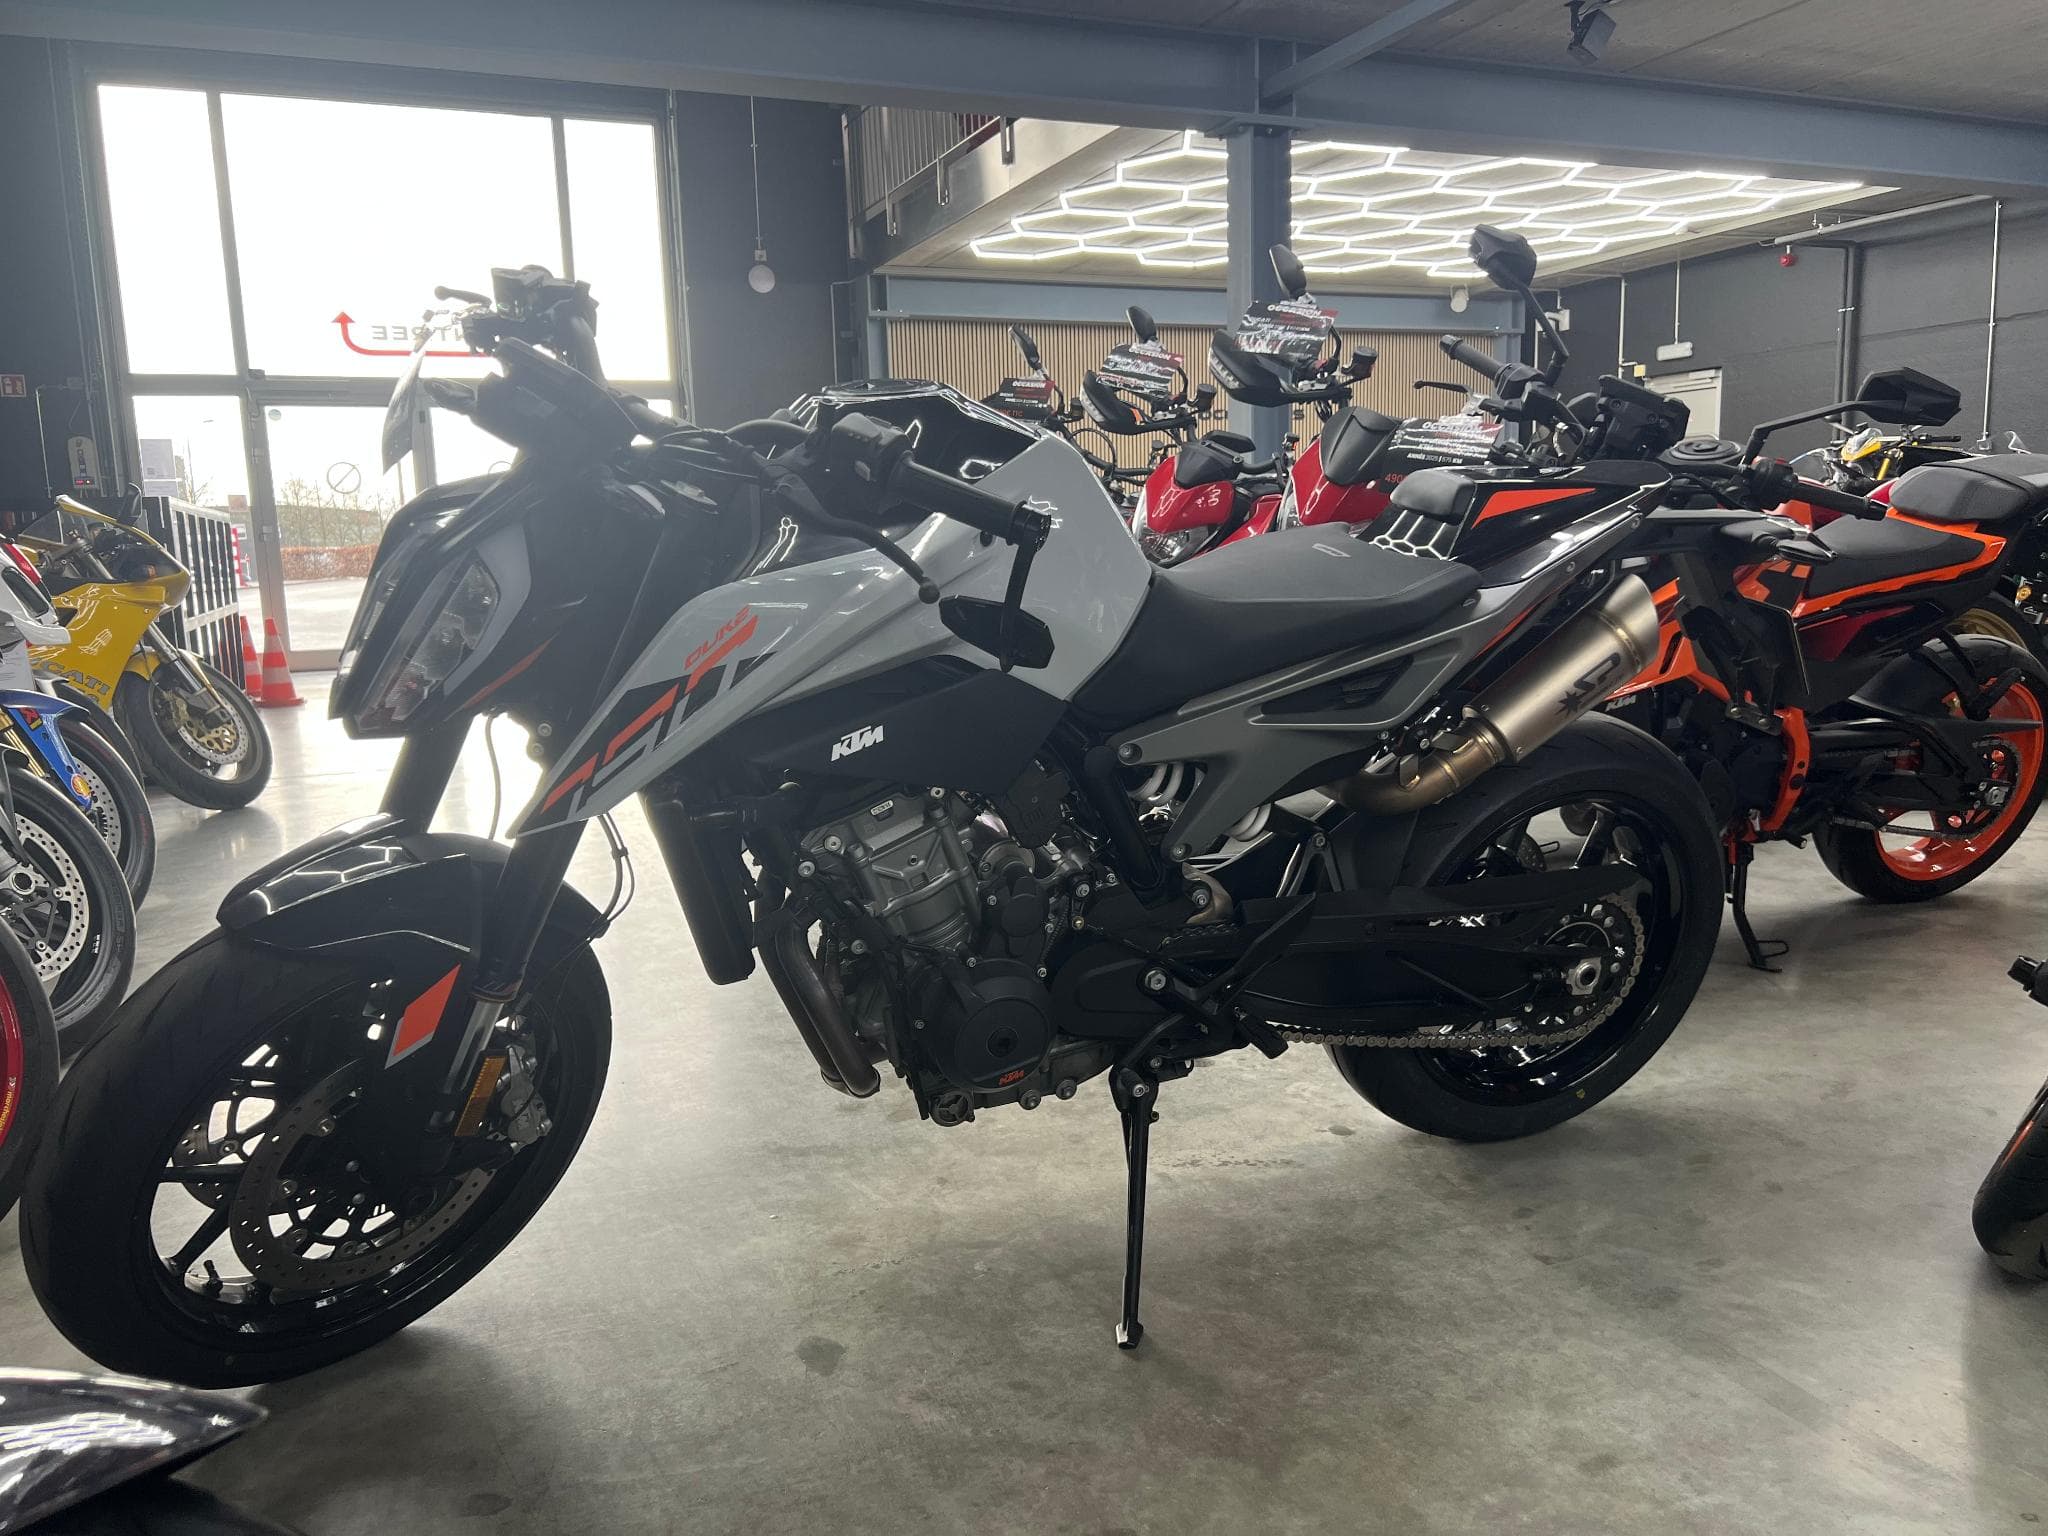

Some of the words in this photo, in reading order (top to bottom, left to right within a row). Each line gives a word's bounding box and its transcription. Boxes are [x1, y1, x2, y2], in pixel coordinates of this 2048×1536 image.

[1267, 304, 1322, 317] OCCASION
[1012, 380, 1047, 389] OCCASION
[683, 604, 751, 671] DUKE
[831, 725, 884, 762] KTM
[999, 1070, 1025, 1086] KTM
